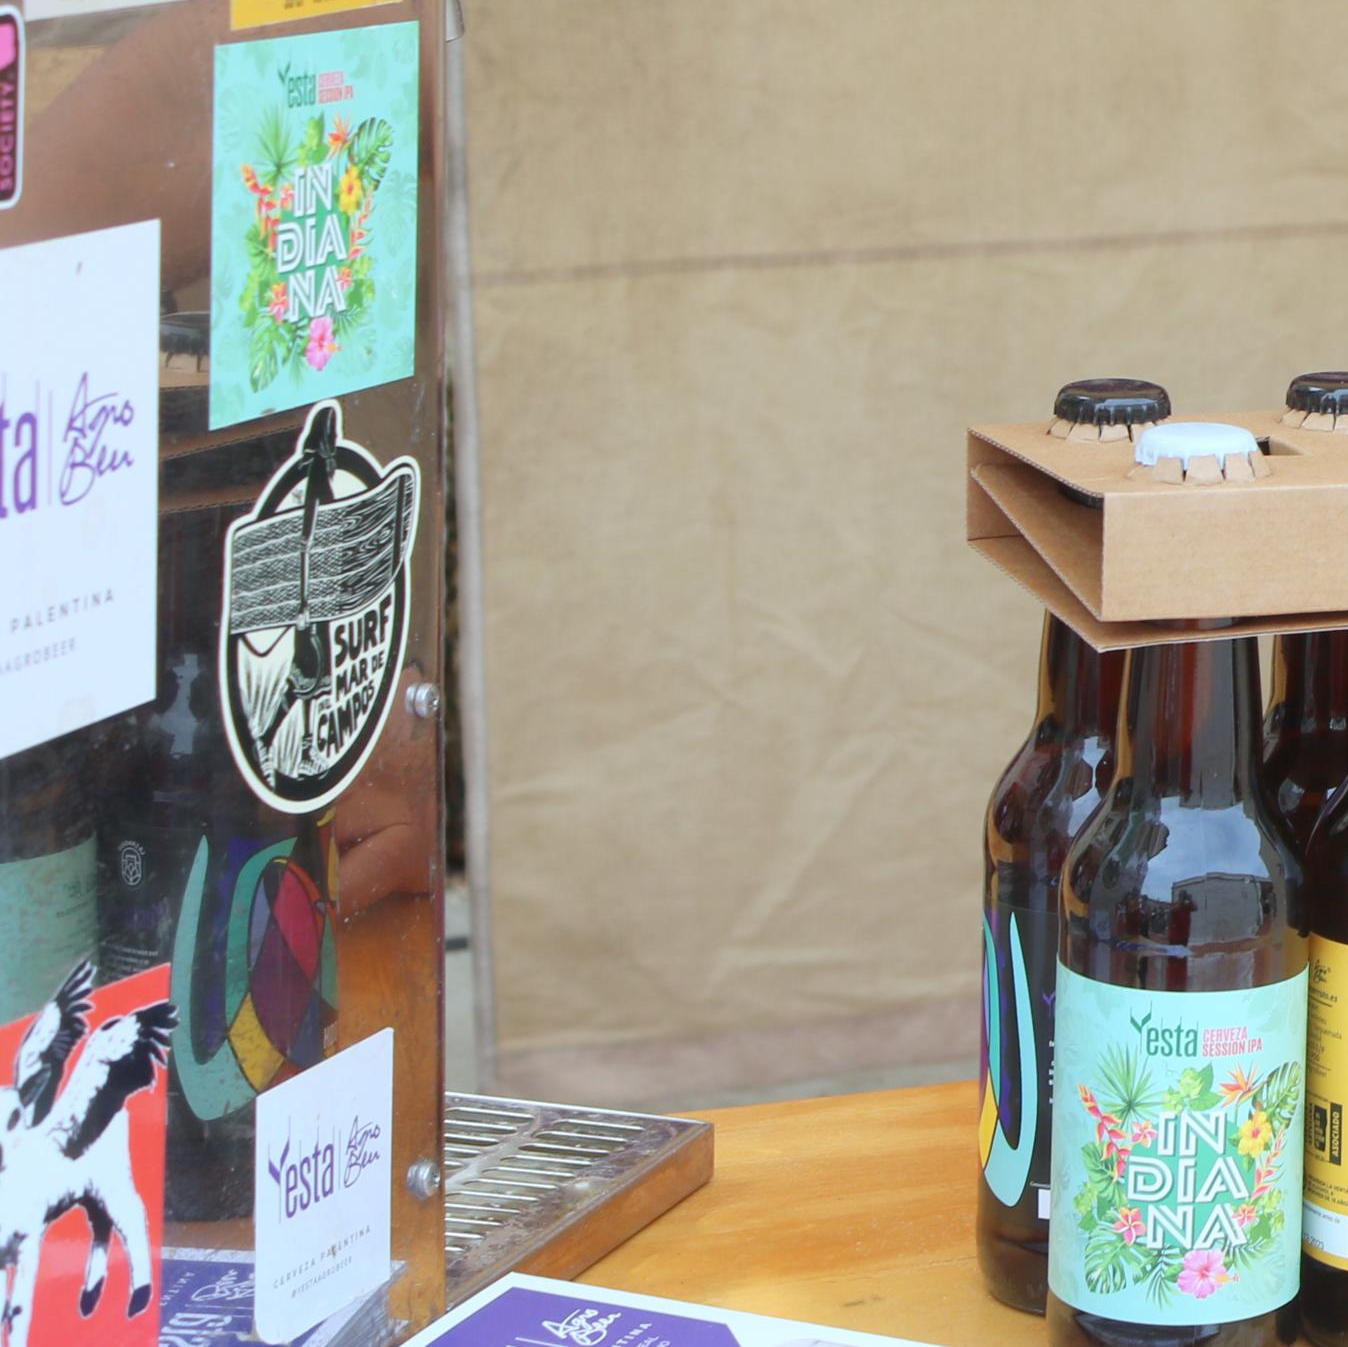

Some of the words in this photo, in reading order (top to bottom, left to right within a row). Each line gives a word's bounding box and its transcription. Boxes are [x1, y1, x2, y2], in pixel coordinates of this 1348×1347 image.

[278, 63, 316, 108] Yesta
[294, 163, 332, 218] IN
[277, 214, 347, 274] DIA
[289, 265, 347, 324] NA
[10, 588, 115, 635] PALENTINA
[334, 594, 391, 668] SURF
[336, 658, 368, 702] MAR
[371, 650, 384, 675] DE
[317, 680, 375, 759] CAMPOS
[1130, 1000, 1199, 1057] Yesta
[1202, 1041, 1245, 1057] SESSION
[1248, 1038, 1263, 1053] IPA
[1203, 1027, 1247, 1043] CERVEZA
[1157, 1111, 1227, 1158] IN
[1332, 1111, 1340, 1157] ASOCIADO
[268, 1116, 336, 1222] Yesta
[1126, 1156, 1250, 1204] DIA
[1145, 1203, 1249, 1251] NA
[273, 1258, 316, 1289] CERVEZA
